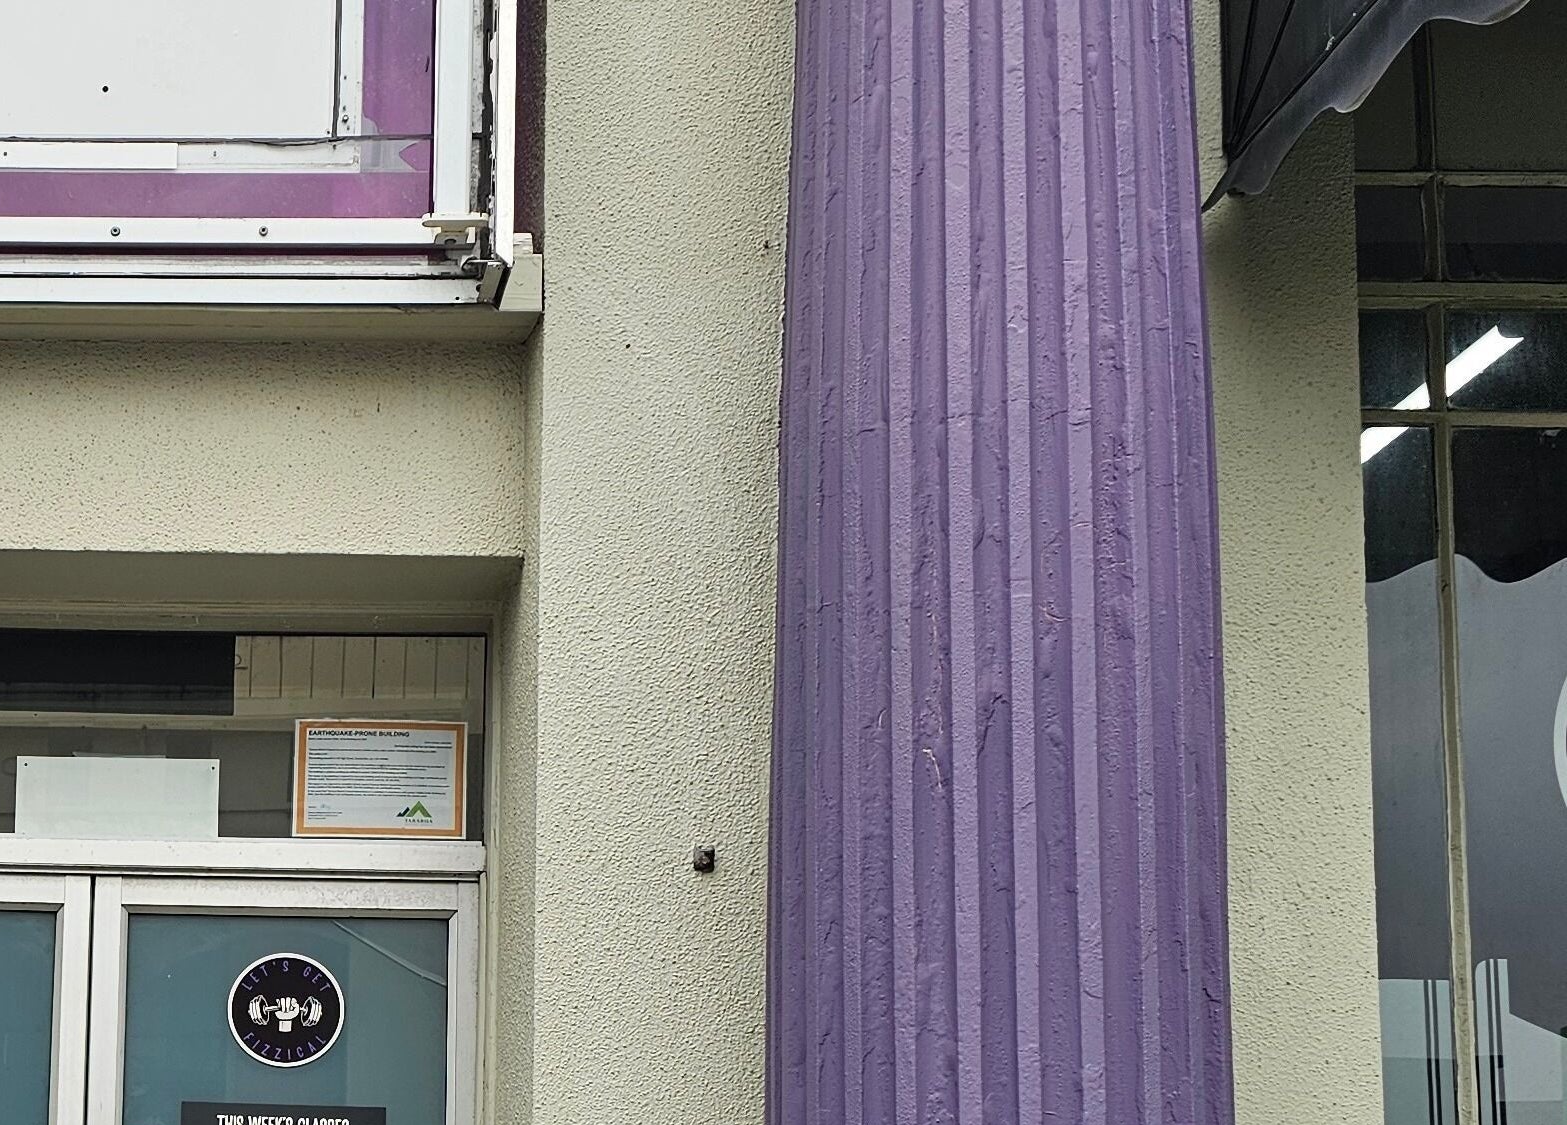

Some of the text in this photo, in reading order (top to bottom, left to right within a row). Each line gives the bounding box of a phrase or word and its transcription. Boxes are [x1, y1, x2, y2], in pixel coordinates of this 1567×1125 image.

[241, 960, 331, 991] LET'S GET
[243, 1032, 327, 1060] FIZZICAL
